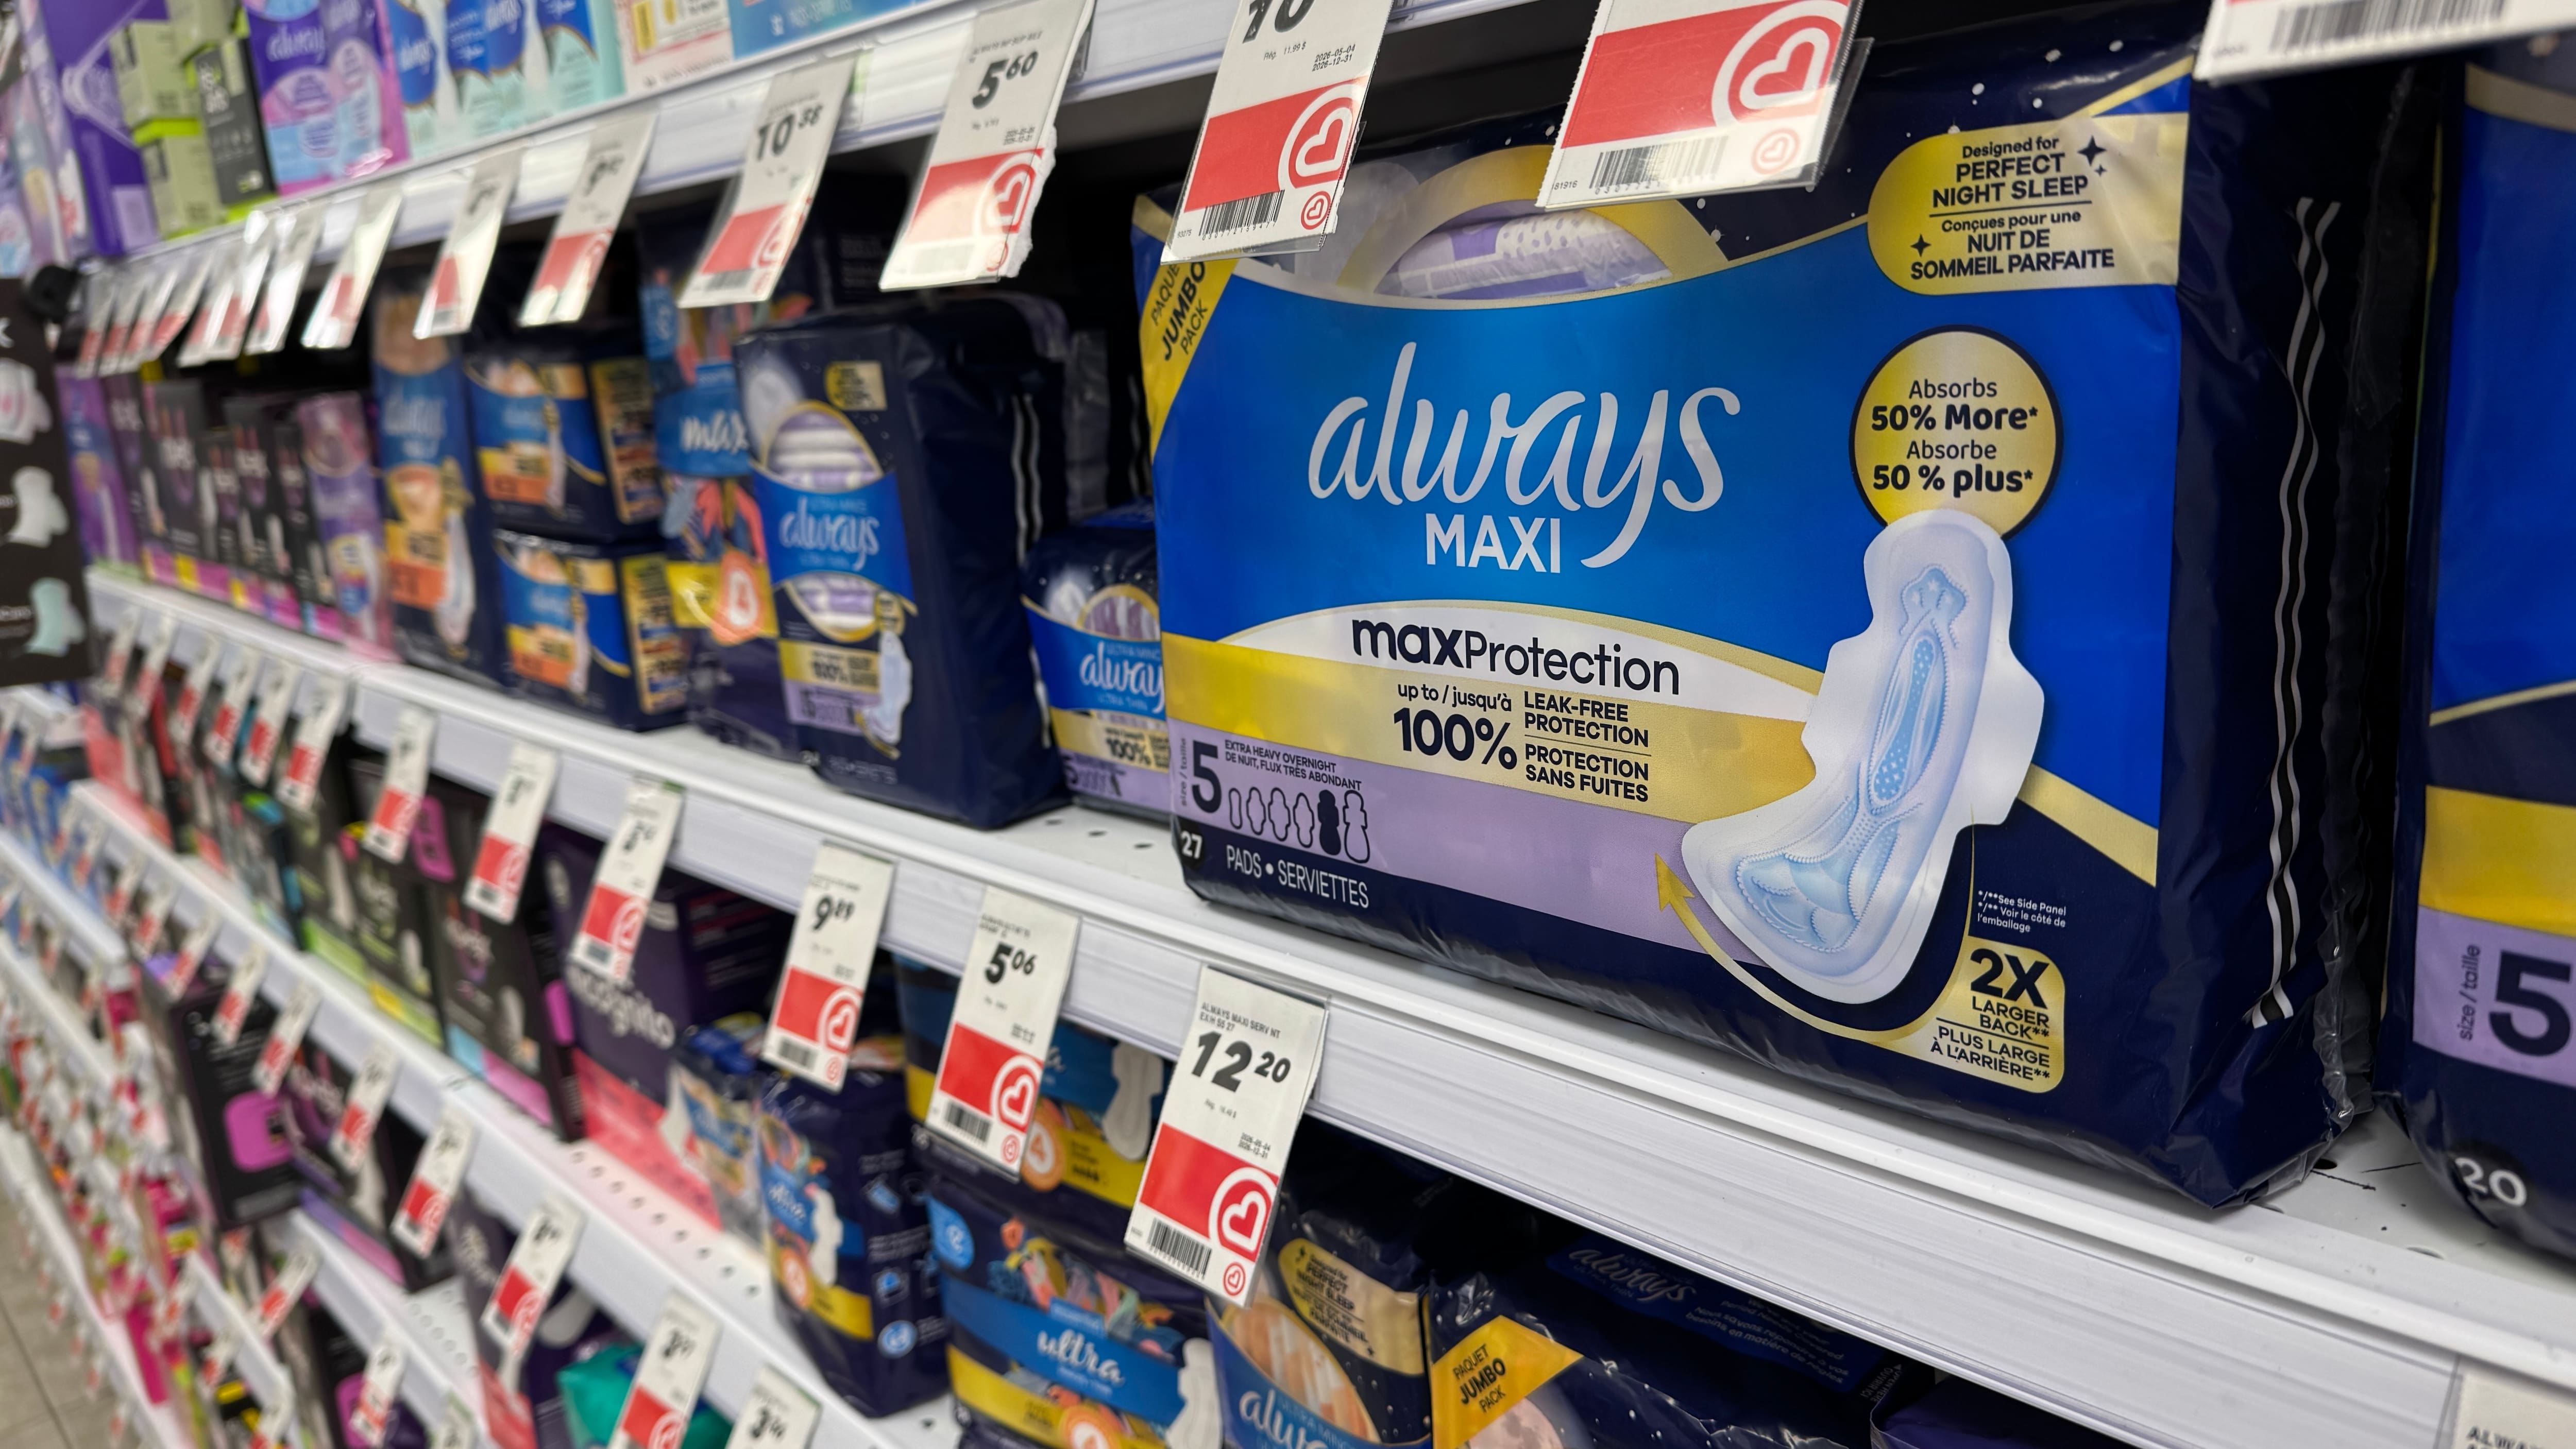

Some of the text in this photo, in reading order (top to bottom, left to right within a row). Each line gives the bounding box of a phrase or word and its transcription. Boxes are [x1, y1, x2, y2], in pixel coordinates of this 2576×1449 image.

[1284, 43, 1300, 55] 11.99
[1312, 54, 1352, 72] 2026-12-31
[1315, 44, 1355, 62] 2026-05-04
[972, 59, 1010, 110] 5
[757, 112, 795, 162] 10
[1962, 136, 2059, 159] Designed for
[1956, 152, 2065, 182] PERFECT
[1932, 175, 2088, 208] NIGHT SLEEP
[1942, 211, 2081, 233] Conçues pour une
[1968, 229, 2050, 253] NUIT DE
[1911, 248, 2114, 280] SOMMEIL PARFAITE
[1151, 264, 1180, 326] PAQUE
[1161, 262, 1206, 361] JUMBO
[1180, 299, 1208, 354] PACK
[1908, 378, 1997, 399] Absorbs
[1871, 405, 1936, 431] 50%
[1309, 342, 1740, 568] always
[1906, 440, 1997, 459] Absorbe
[1873, 465, 1910, 490] 50
[1919, 465, 1945, 490] %
[1425, 513, 1561, 574] MAXI
[1352, 619, 1680, 695] maxProtection
[1080, 641, 1164, 713] alway
[1398, 683, 1512, 712] up to / jusqu'à
[1524, 691, 1629, 723] LEAK-FREE
[1394, 707, 1517, 770] 100%
[1524, 712, 1649, 748] PROTECTION
[1225, 739, 1336, 773] EXTRA HEAVY OVERNIGHT
[1225, 752, 1362, 791] DE NUIT, FLUX TRÈS ABONDANT
[1525, 743, 1649, 781] PROTECTION
[1191, 739, 1222, 813] 5
[1526, 764, 1649, 803] SANS FUITES
[1181, 830, 1203, 860] 27
[1226, 844, 1369, 909] PADS SERVIETTES
[1977, 912, 2031, 933] l'emballage
[2000, 907, 2019, 918] Voir
[2021, 910, 2029, 920] le
[2031, 913, 2052, 925] côté
[2054, 916, 2066, 928] de
[2017, 898, 2038, 910] Side
[2040, 902, 2066, 916] Panel
[985, 941, 1038, 984] 5 06
[1970, 948, 2049, 1009] 2X
[2461, 944, 2481, 990] taille
[1201, 1002, 1281, 1039] ALWAYS MAXI SERV NT
[1972, 996, 2049, 1028] LARGER
[2488, 949, 2573, 1058] 5
[2459, 1004, 2472, 1041] size
[1191, 1030, 1291, 1093] 12 20
[1930, 1037, 1943, 1055] À
[1938, 1025, 2049, 1068] PLUS LARGE
[2454, 1157, 2527, 1207] 20
[1568, 1249, 1697, 1303] always
[1685, 1311, 1728, 1333] besoins
[1728, 1328, 1743, 1338] en
[1743, 1333, 1789, 1355] matière
[1790, 1351, 1806, 1362] de
[1723, 1314, 1763, 1333] savons
[1829, 1364, 1849, 1376] vos
[1038, 1329, 1125, 1387] ultra
[1452, 1343, 1489, 1380] PAQUET
[1460, 1357, 1506, 1405] JUMBO
[1479, 1384, 1506, 1413] PACK
